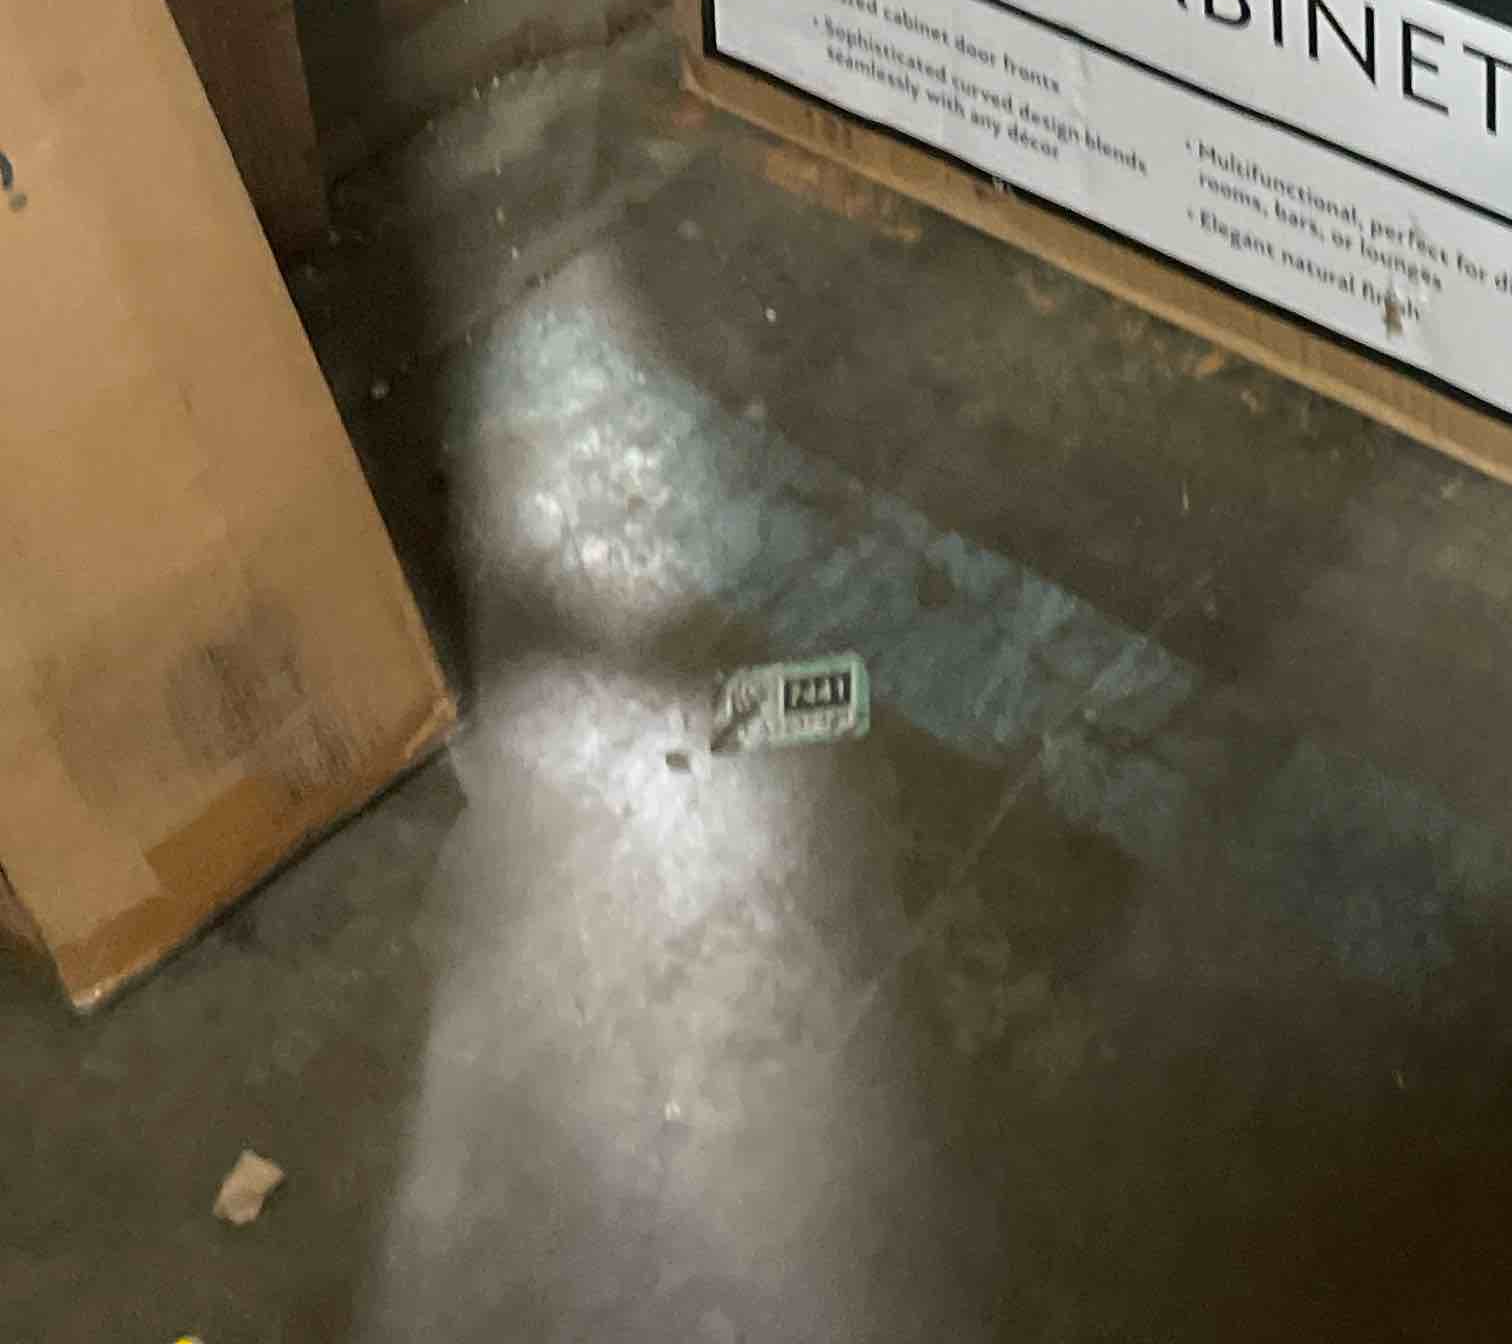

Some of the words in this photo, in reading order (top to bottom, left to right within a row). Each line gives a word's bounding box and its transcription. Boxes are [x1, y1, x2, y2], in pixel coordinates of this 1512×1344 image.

[824, 15, 947, 84] Sophisticated
[951, 70, 1014, 112] curved
[1018, 96, 1082, 143] design
[1084, 126, 1148, 176] blends
[826, 45, 921, 101] seamlessly
[925, 86, 966, 119] with
[970, 108, 1002, 138] any
[883, 0, 950, 49] cabinet
[954, 32, 997, 65] door
[1003, 50, 1061, 94] fronts
[1199, 141, 1363, 233] Multifunctional,
[1370, 216, 1450, 267] perfect
[1456, 250, 1487, 283] for
[1199, 172, 1269, 218] rooms,
[1274, 198, 1325, 244] bars,
[1331, 230, 1353, 251] or
[1359, 240, 1443, 291] lounges
[1200, 209, 1276, 261] Elegant
[1281, 249, 1356, 294] natural
